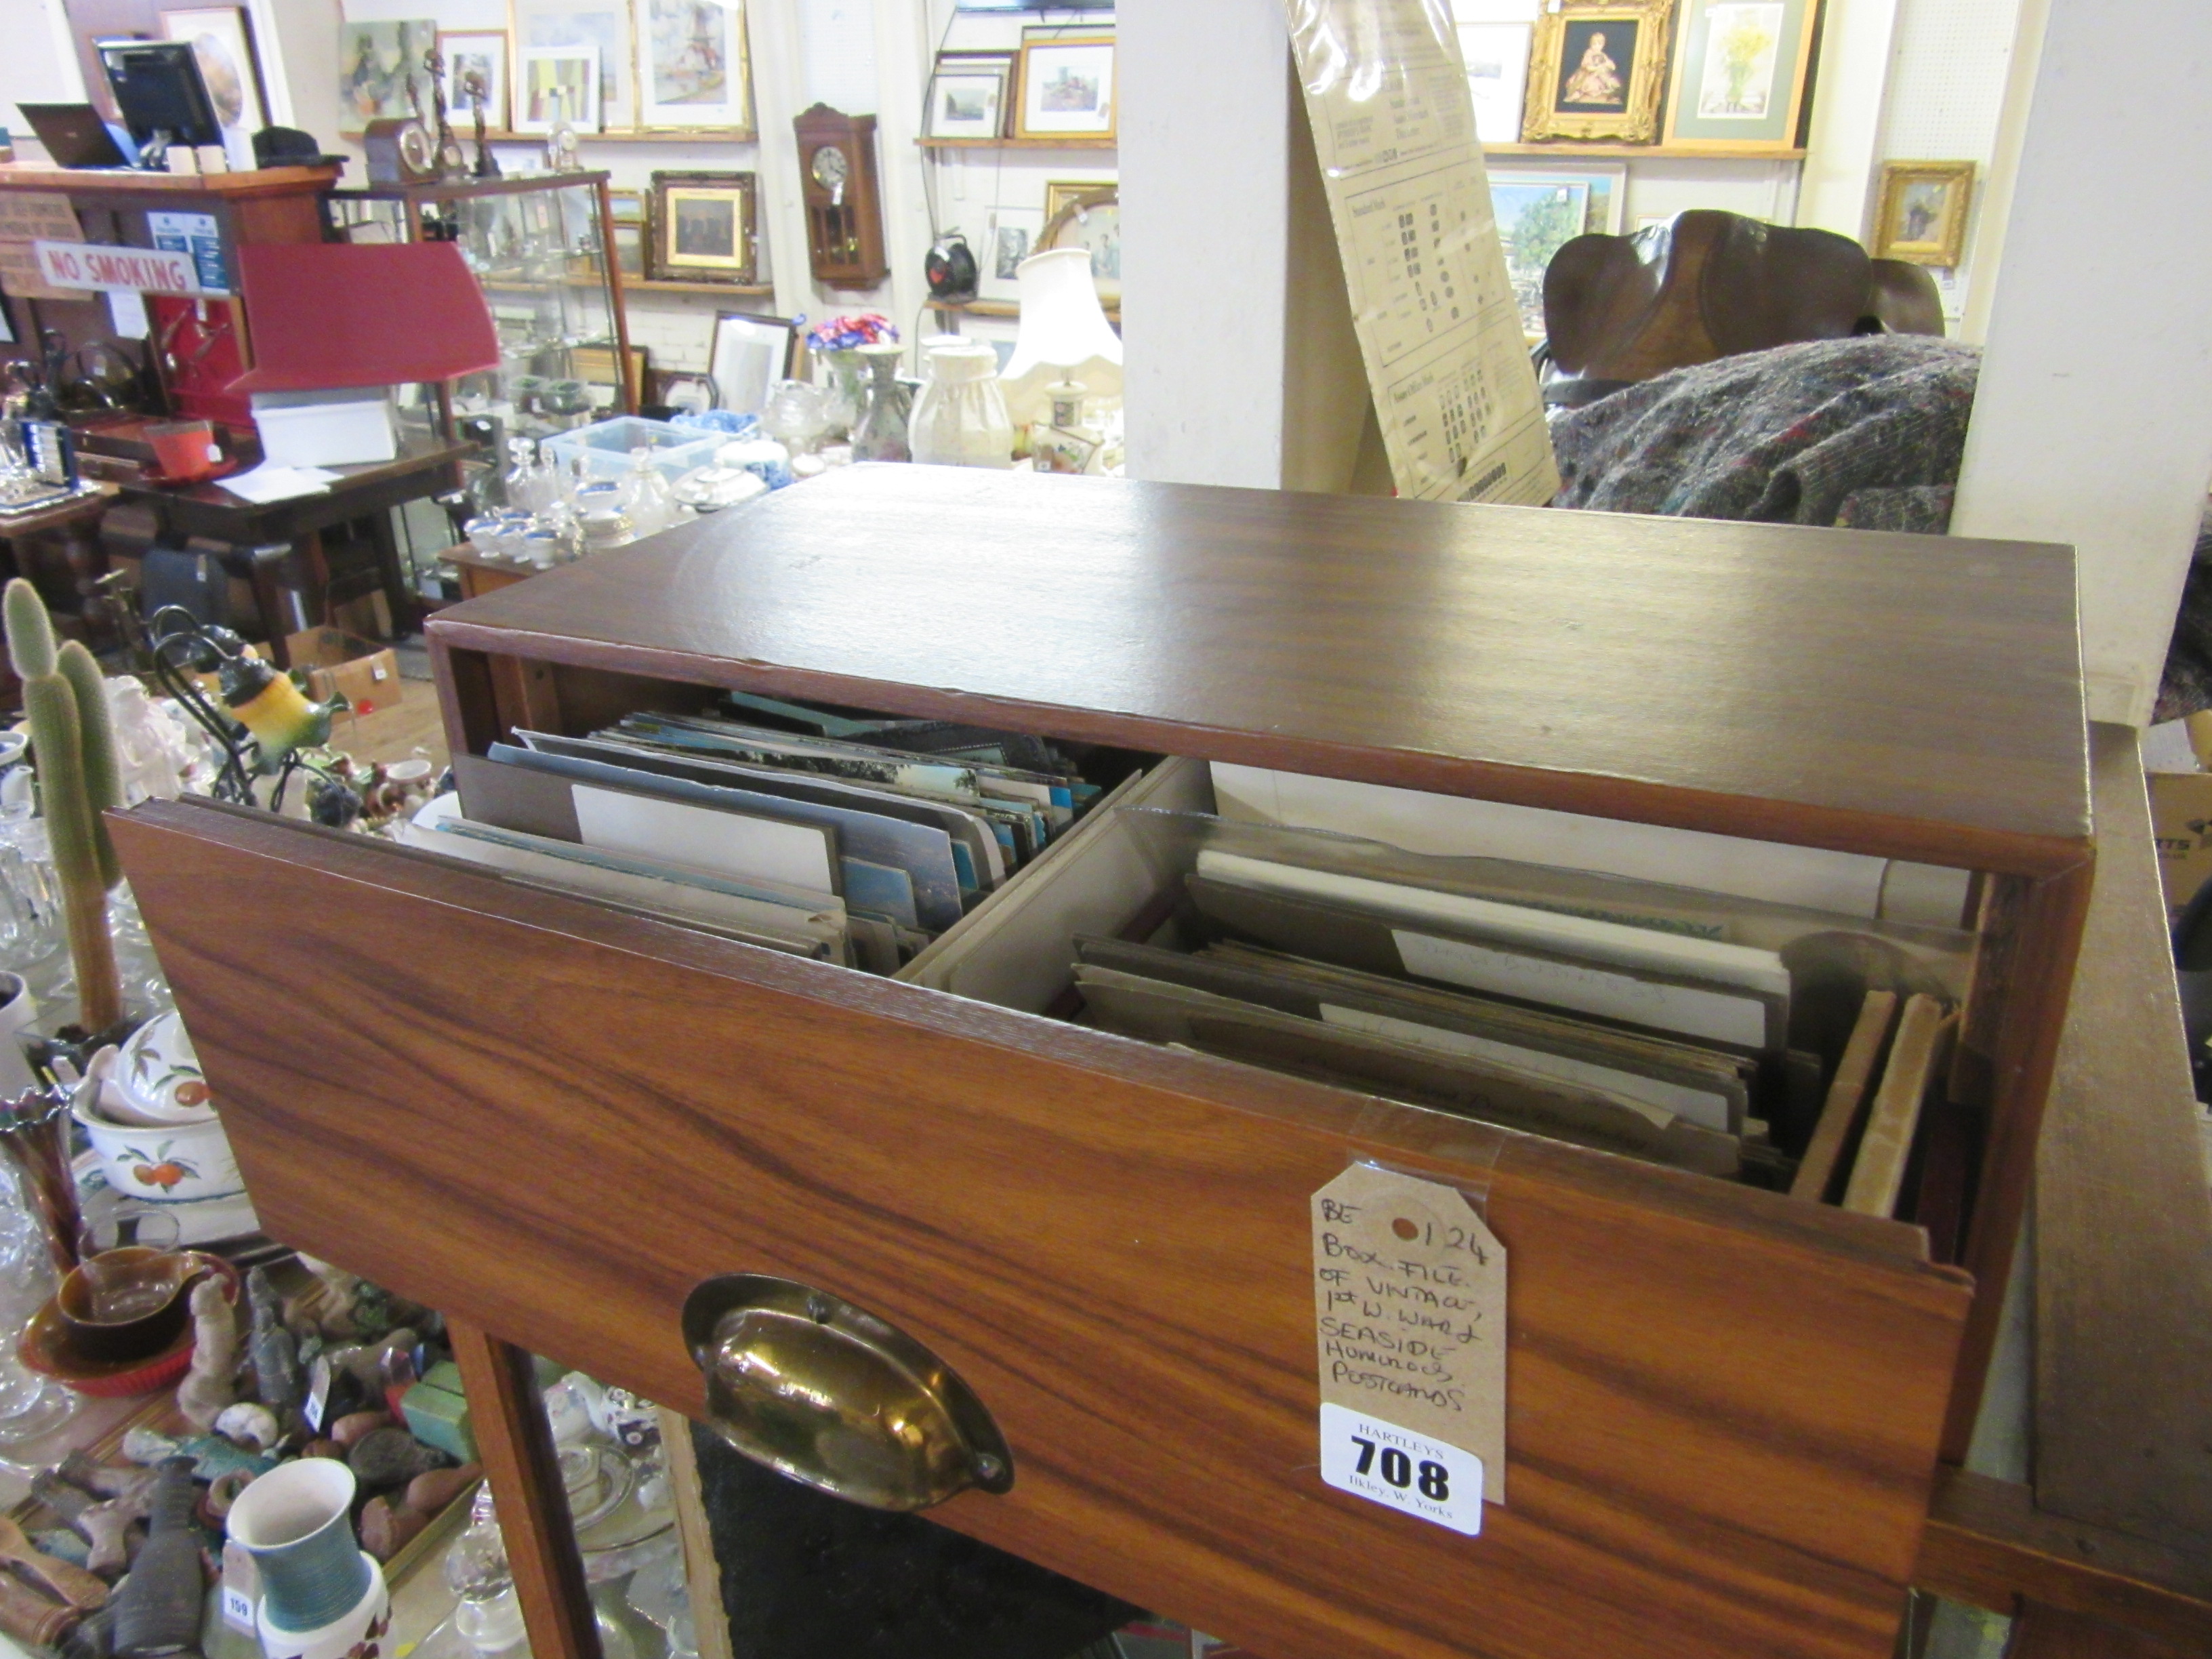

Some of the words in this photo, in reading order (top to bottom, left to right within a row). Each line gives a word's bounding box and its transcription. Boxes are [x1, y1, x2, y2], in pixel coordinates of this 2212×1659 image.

[46, 249, 81, 281] NO
[84, 253, 187, 291] SMOKING
[1425, 1221, 1489, 1266] 124
[1319, 1316, 1456, 1360] SEASIDE
[1359, 1422, 1444, 1459] HARTLEYS
[1351, 1434, 1450, 1502] 708
[1416, 1497, 1453, 1519] Yorks
[230, 1597, 248, 1617] 159
